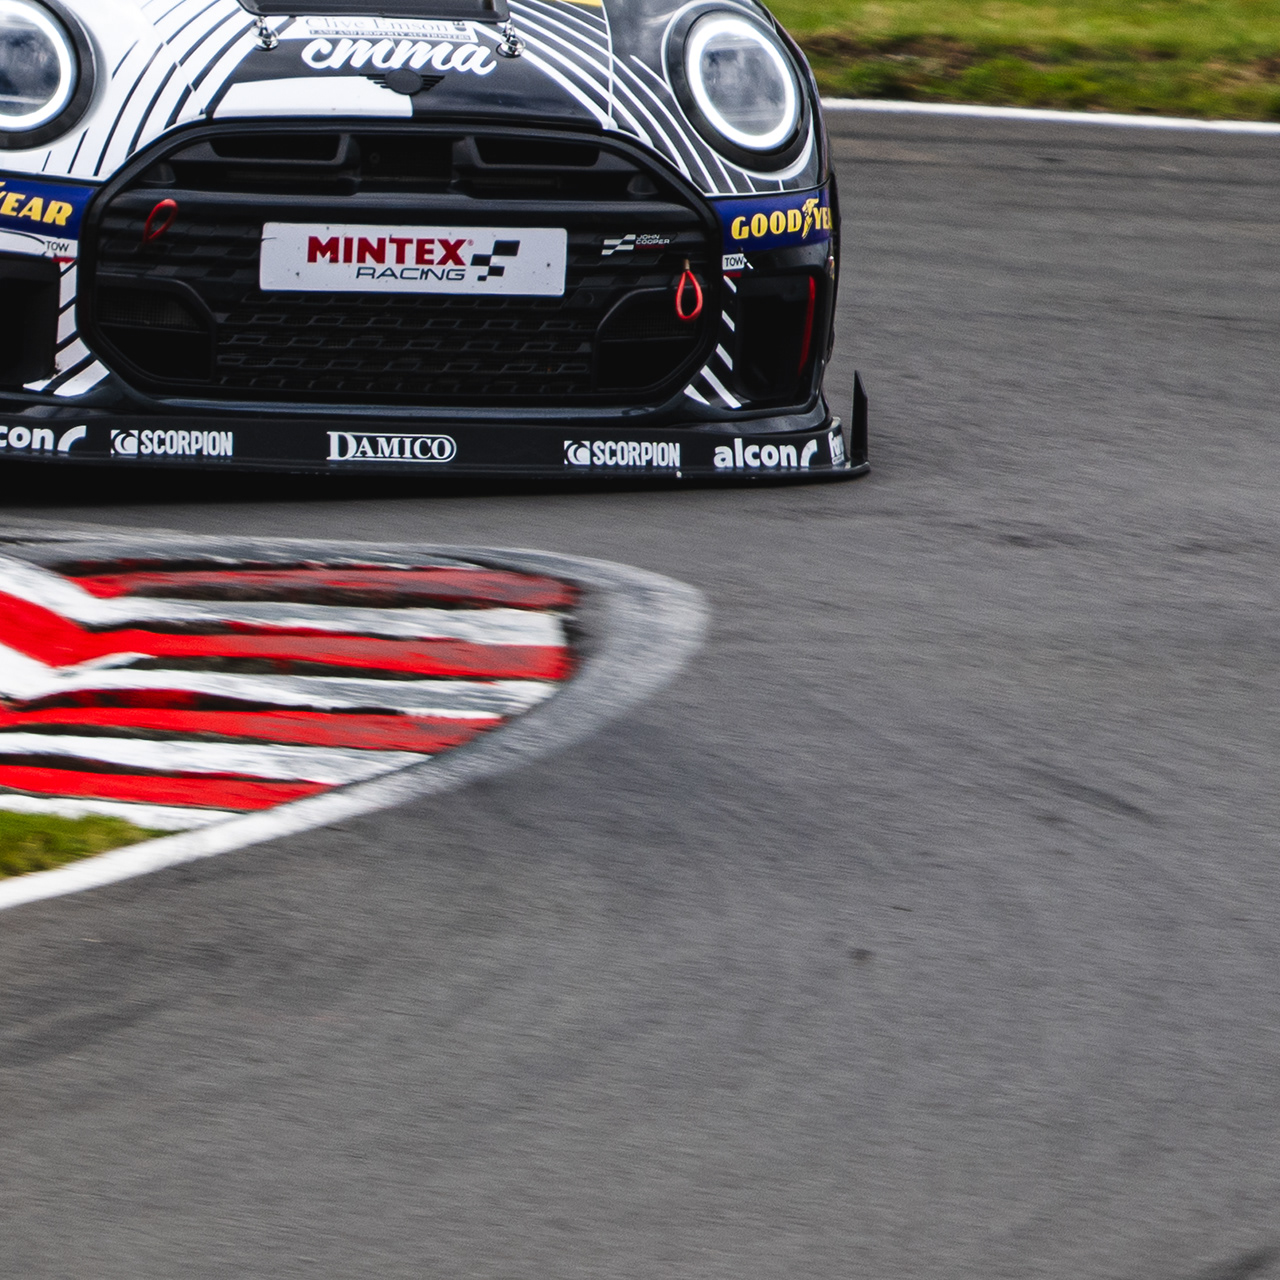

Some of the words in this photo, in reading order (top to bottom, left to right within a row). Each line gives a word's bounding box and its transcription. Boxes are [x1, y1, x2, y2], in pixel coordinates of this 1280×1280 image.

[45, 241, 69, 253] TOW
[307, 236, 468, 266] MINTEX
[355, 267, 467, 282] RACING
[724, 255, 744, 267] TOW
[140, 429, 233, 457] SCORPION
[592, 440, 680, 467] SCORPION
[713, 437, 797, 468] alcon
